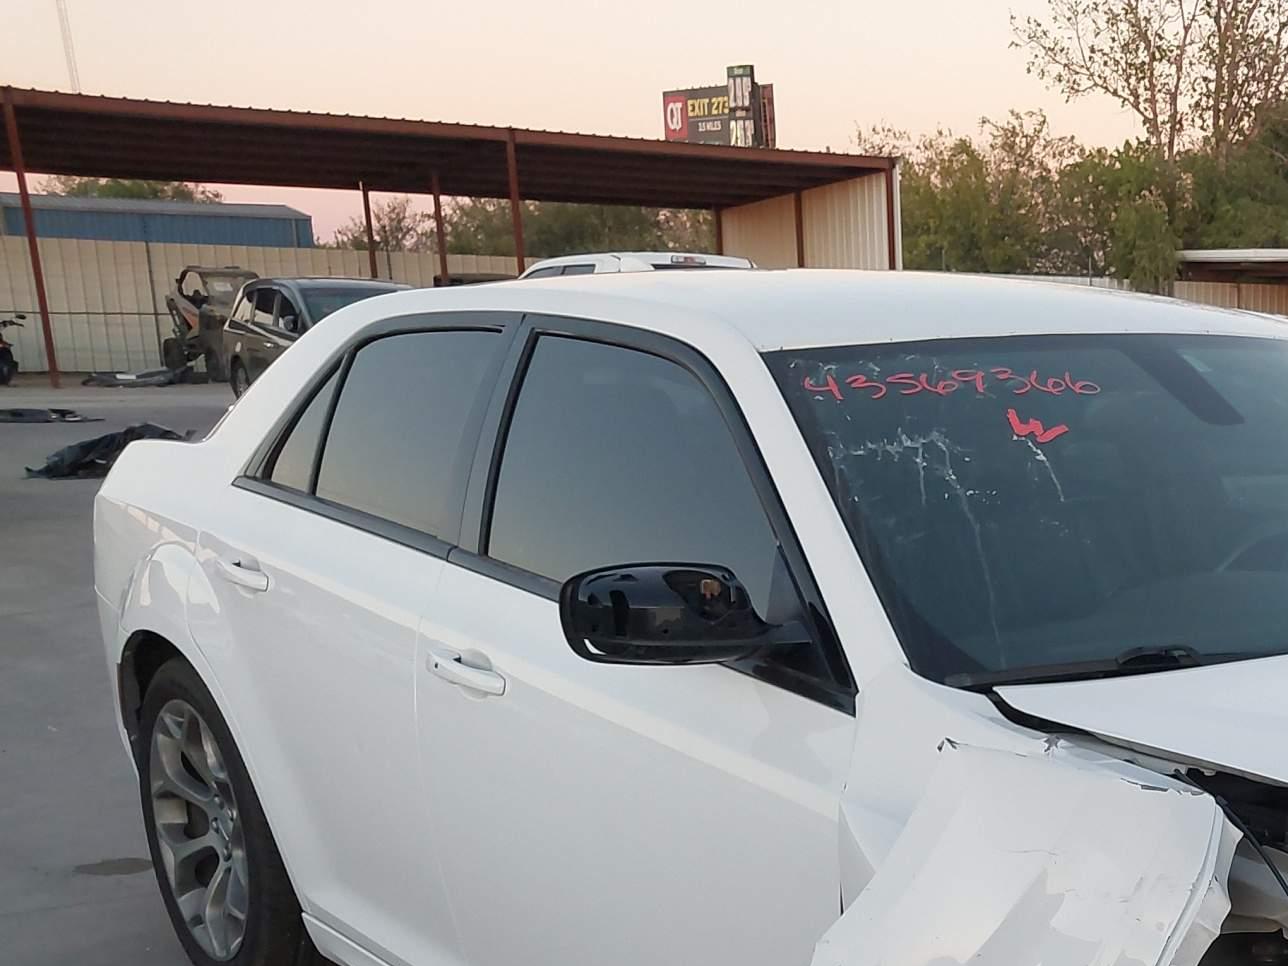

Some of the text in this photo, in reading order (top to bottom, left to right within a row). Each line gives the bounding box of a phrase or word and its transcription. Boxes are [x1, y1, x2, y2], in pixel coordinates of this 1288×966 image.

[667, 101, 683, 131] QT
[687, 98, 709, 117] EXIT
[803, 368, 1101, 401] 43569366
